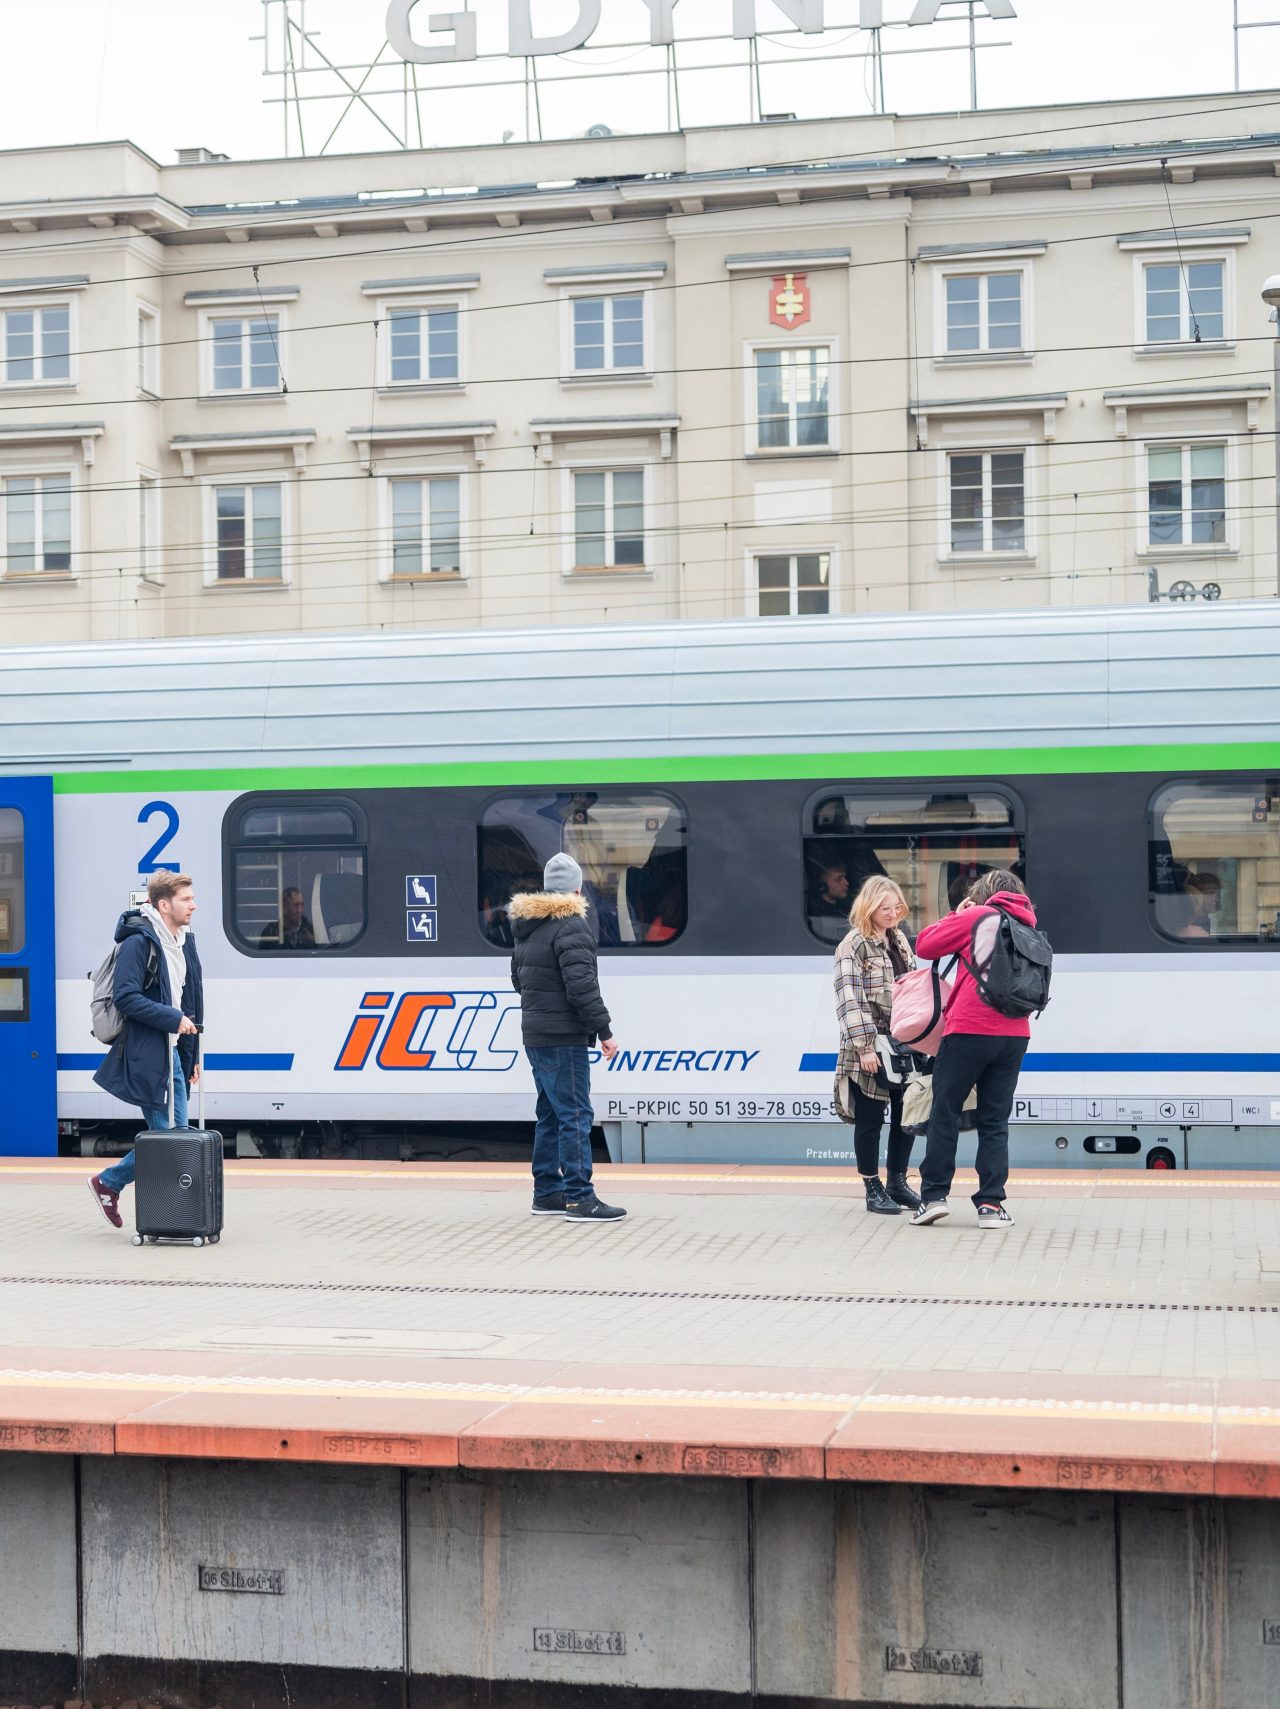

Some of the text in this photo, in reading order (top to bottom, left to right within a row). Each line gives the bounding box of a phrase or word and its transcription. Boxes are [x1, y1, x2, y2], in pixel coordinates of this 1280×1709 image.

[137, 800, 181, 874] 2
[607, 1050, 761, 1072] INTERCITY
[608, 1101, 681, 1116] PL-PKPIC
[689, 1101, 708, 1116] 50
[715, 1102, 731, 1116] 51
[737, 1102, 786, 1116] 39-78
[1016, 1101, 1040, 1118] PL
[1187, 1105, 1195, 1116] 4
[203, 1571, 218, 1586] 06
[220, 1570, 266, 1589] Sibet
[555, 1631, 604, 1651] Sibet
